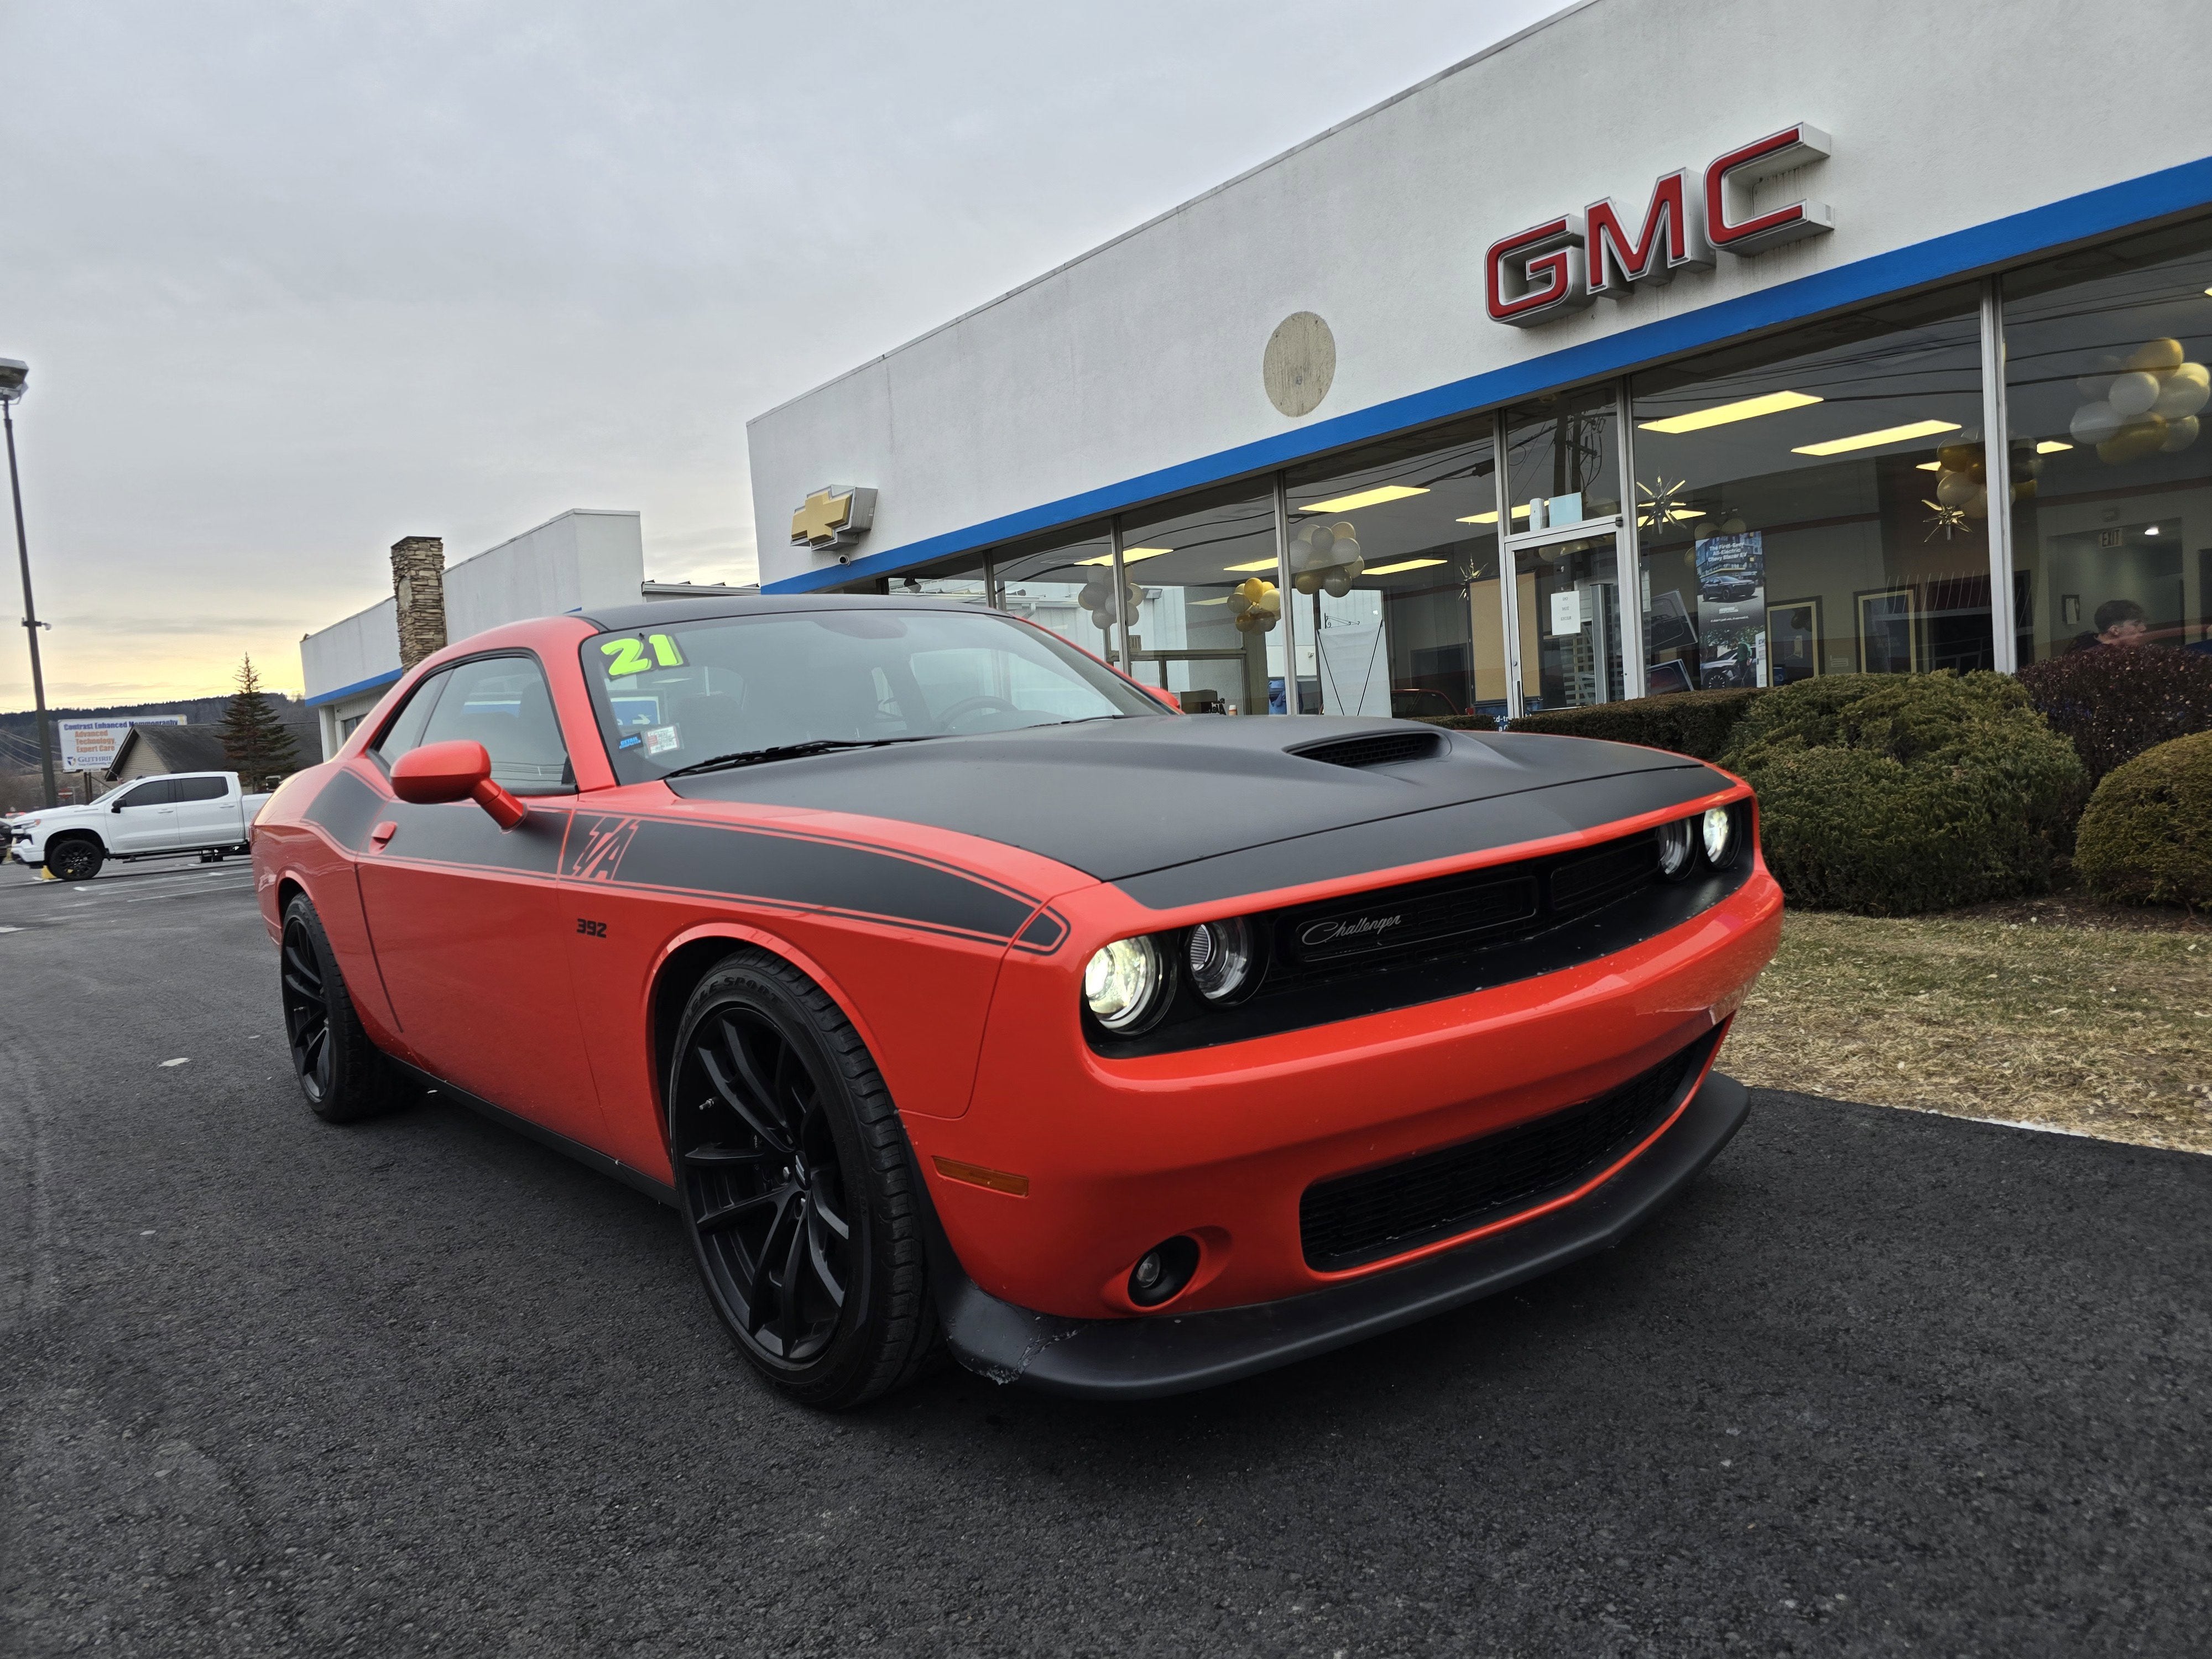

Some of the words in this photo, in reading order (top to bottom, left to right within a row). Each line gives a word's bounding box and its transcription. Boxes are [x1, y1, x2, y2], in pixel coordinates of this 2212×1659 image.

[1485, 122, 1819, 325] GMC
[2102, 530, 2119, 547] EXIT
[601, 634, 684, 676] 21
[576, 918, 607, 938] 392
[1302, 915, 1401, 945] Challenger
[723, 976, 784, 1004] SPORT
